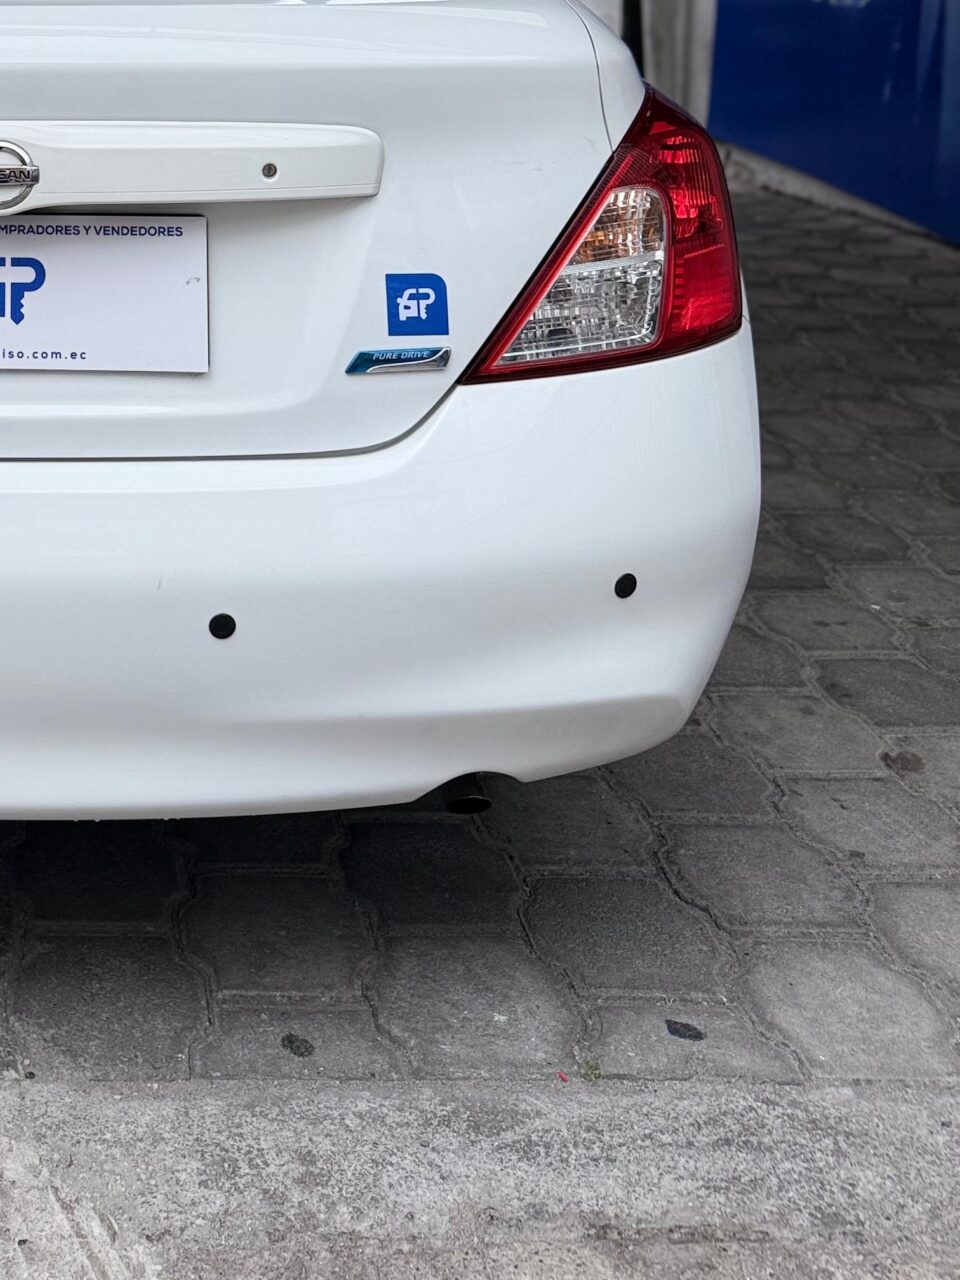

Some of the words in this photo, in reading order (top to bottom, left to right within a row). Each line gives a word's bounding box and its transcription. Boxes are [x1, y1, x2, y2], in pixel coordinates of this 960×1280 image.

[83, 225, 91, 236] Y
[94, 226, 183, 237] VENDEDORES
[372, 351, 399, 360] PURE
[401, 350, 429, 358] DRIVE
